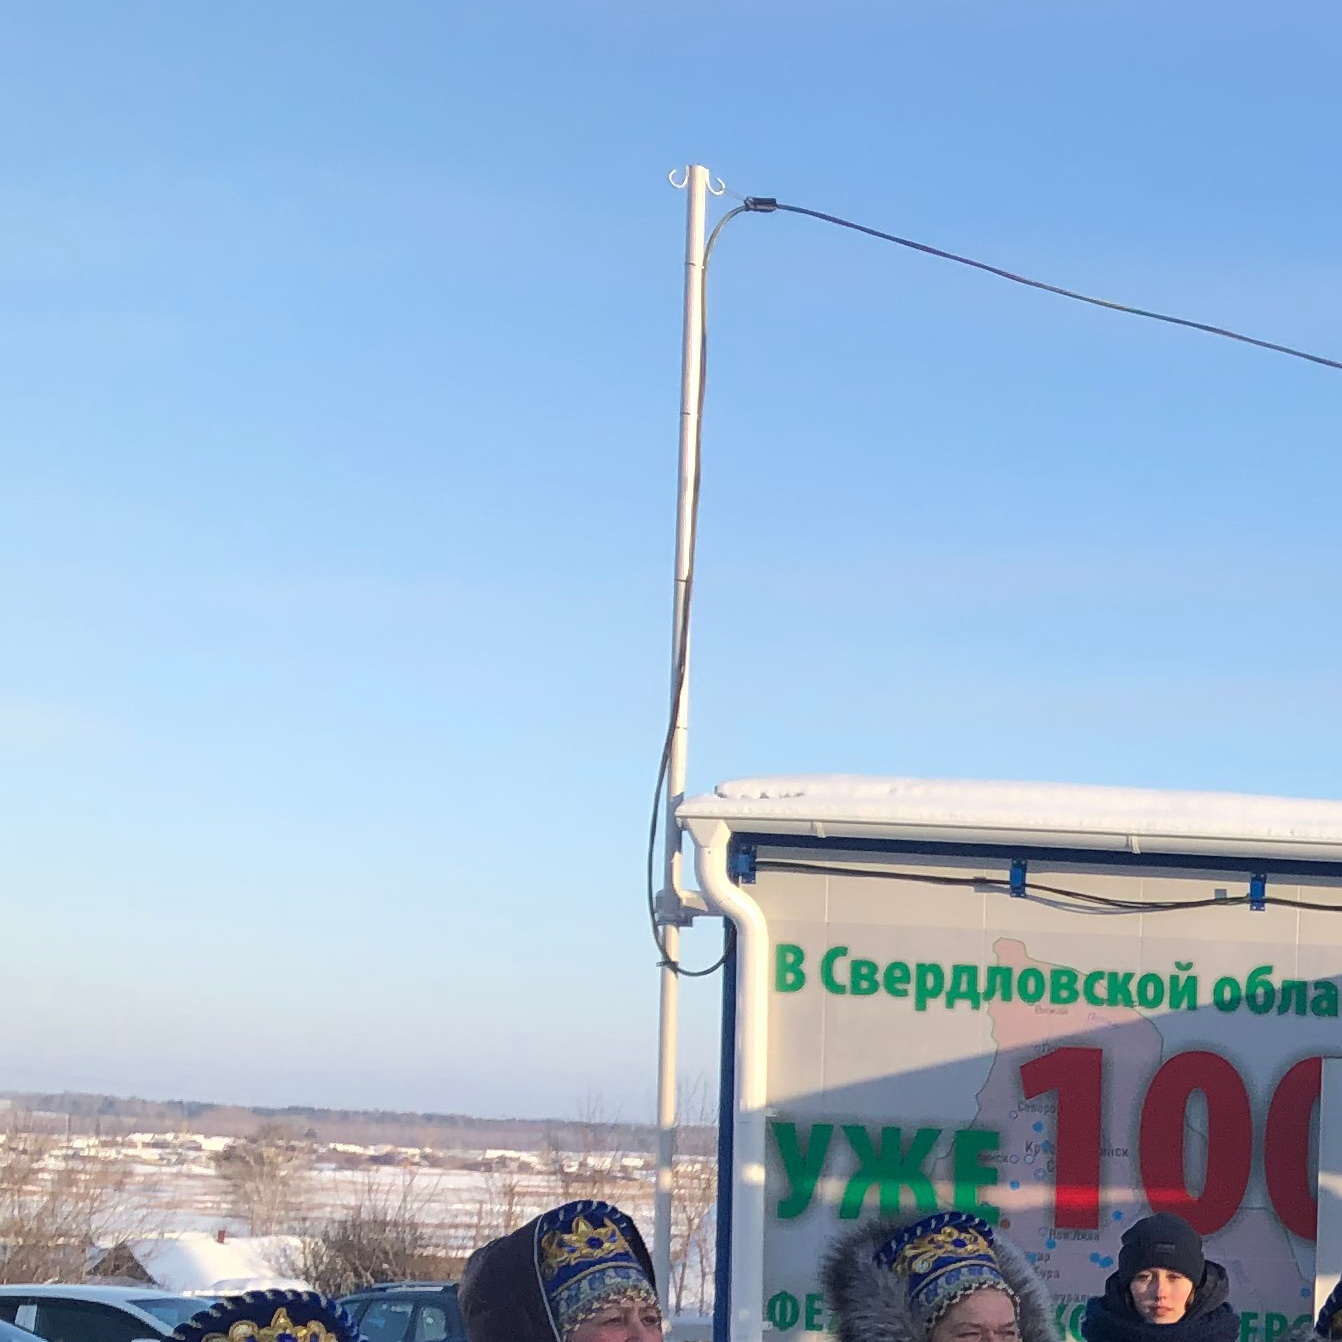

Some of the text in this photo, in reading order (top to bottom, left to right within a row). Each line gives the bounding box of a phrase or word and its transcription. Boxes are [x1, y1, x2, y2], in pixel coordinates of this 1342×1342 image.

[775, 943, 806, 993] В
[820, 945, 1198, 1012] Свердловской
[770, 1121, 1000, 1226] УЖЕ
